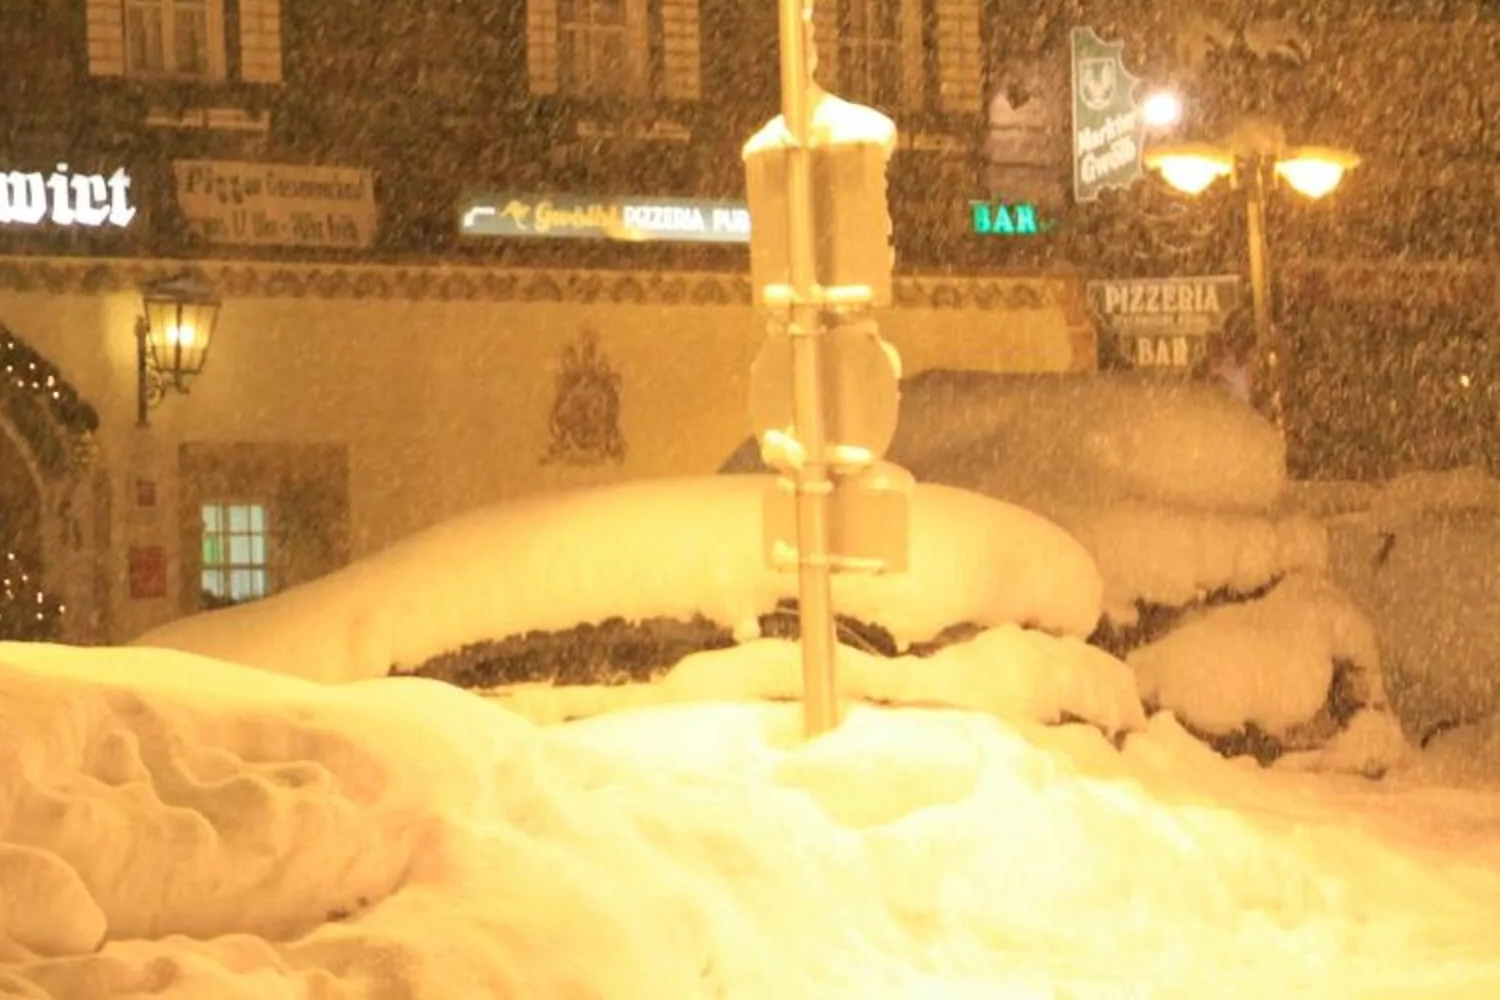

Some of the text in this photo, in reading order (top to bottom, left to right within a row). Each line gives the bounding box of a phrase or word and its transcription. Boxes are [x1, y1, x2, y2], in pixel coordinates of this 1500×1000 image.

[974, 203, 1037, 233] BAR
[1105, 283, 1220, 313] PIZZERIA
[1137, 336, 1189, 366] BAR
